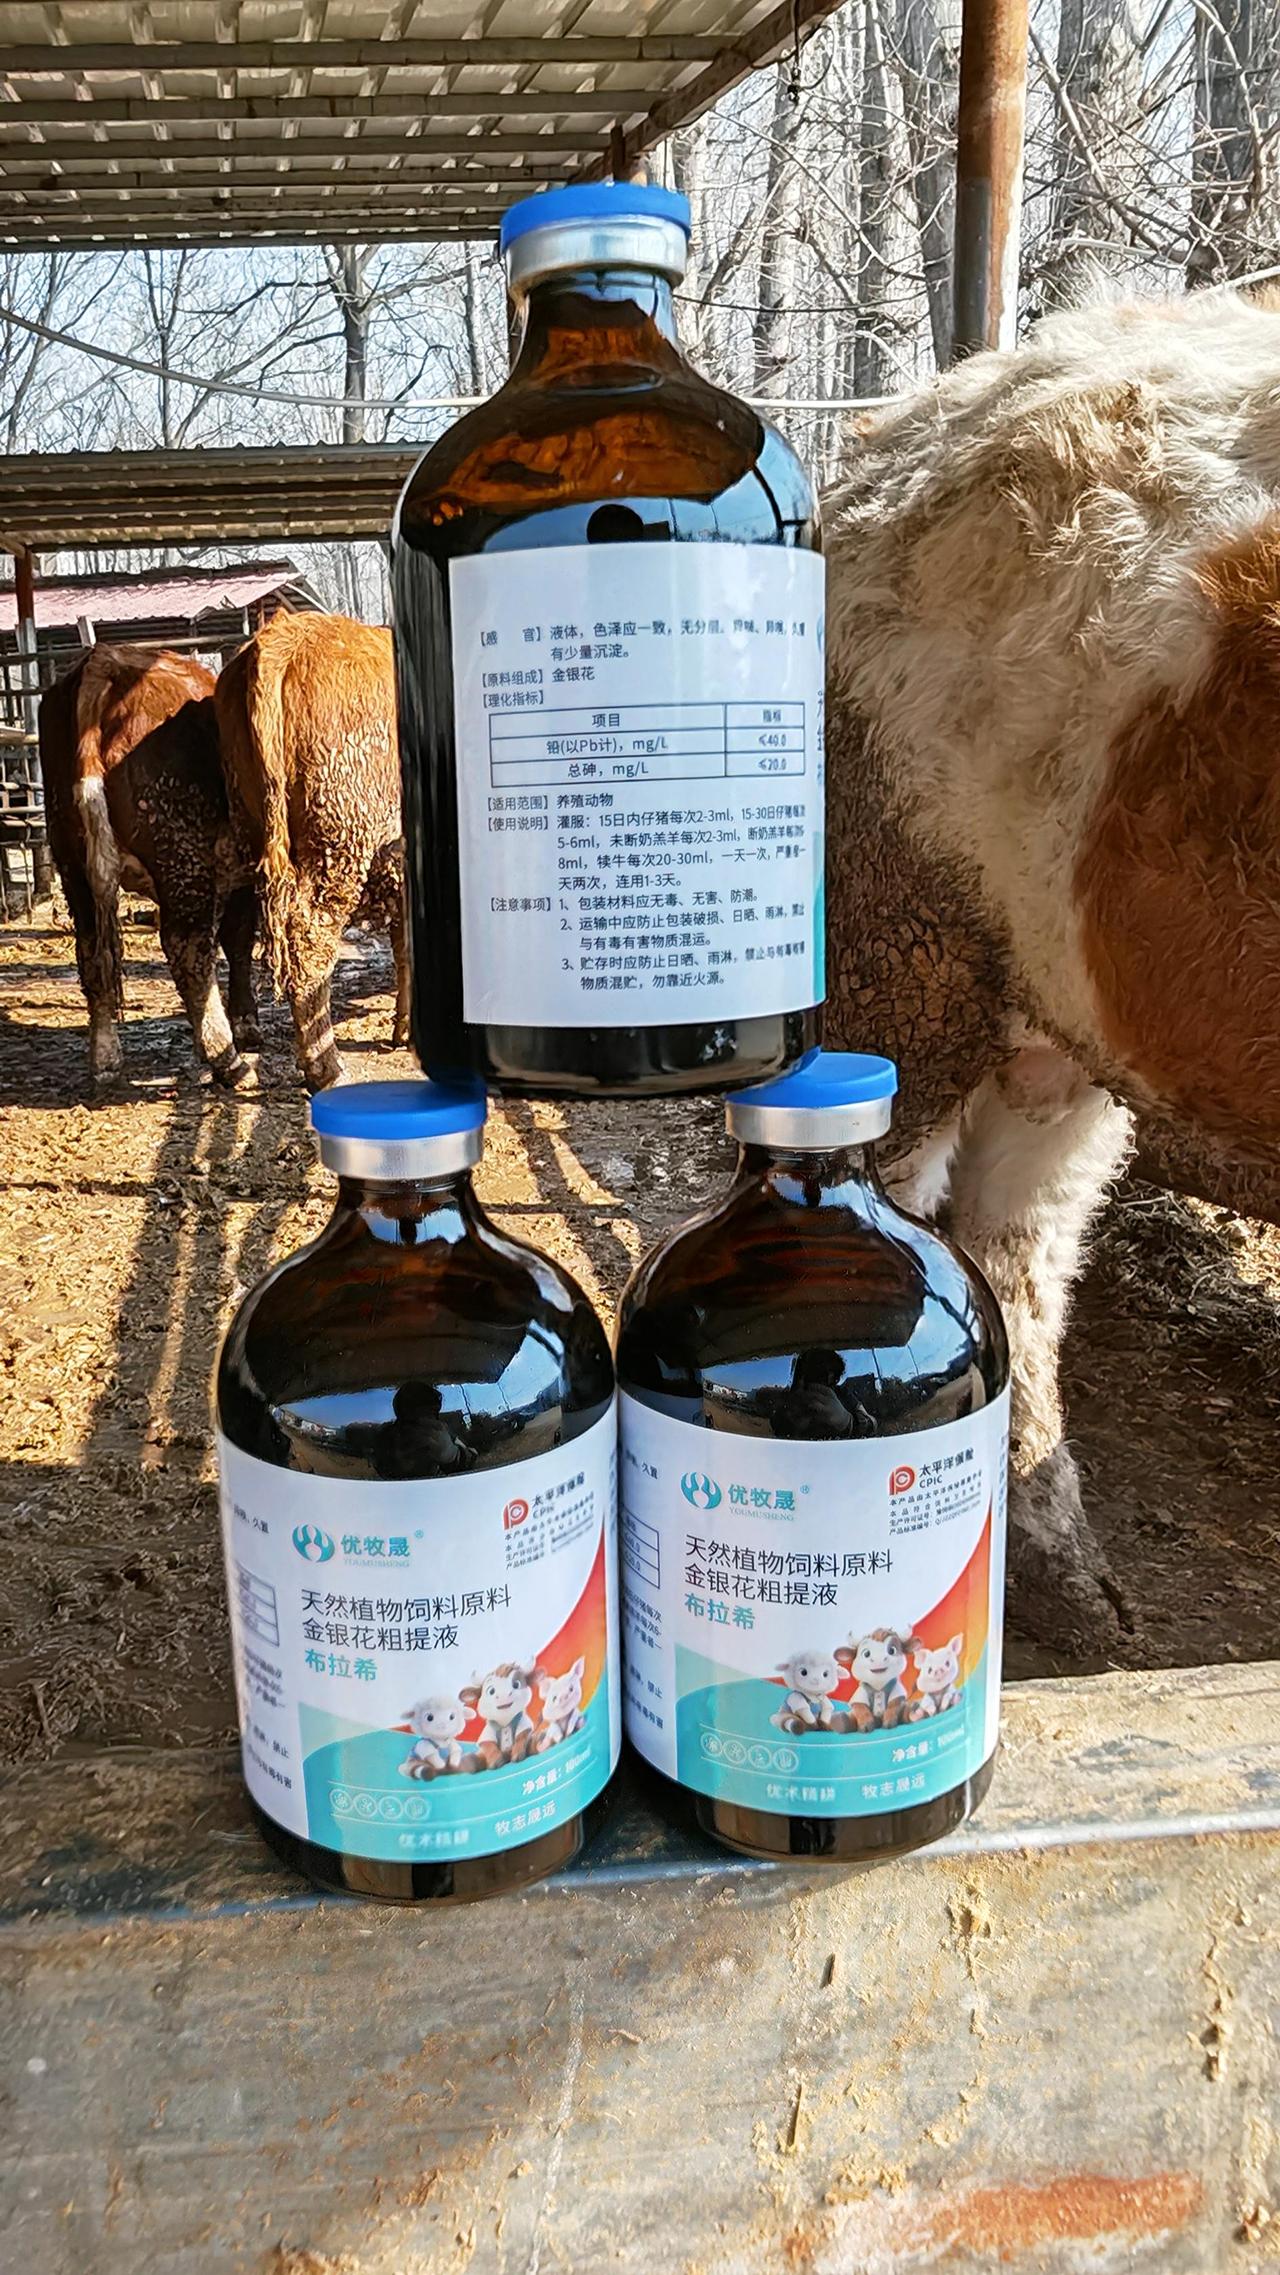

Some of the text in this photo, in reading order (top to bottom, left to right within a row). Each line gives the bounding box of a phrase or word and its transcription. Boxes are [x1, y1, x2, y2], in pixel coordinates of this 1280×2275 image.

[550, 644, 629, 661] 有少量沉淀。
[481, 666, 596, 688] 【原料组成】 金银花
[483, 690, 544, 709] 【理化指标】
[592, 713, 621, 728] 项目
[487, 793, 614, 811] 【适用范围】 养殖动物
[487, 815, 549, 832] 【使用说明】
[558, 874, 682, 891] 天两次，连用1-3天。
[490, 897, 551, 913] 【注意事项】
[579, 933, 712, 951] 与有毒有害物质混运。
[580, 971, 725, 991] 物质混贮，勿靠近火源。
[919, 1475, 943, 1488] CPIC
[727, 1484, 796, 1511] 优牧晟
[341, 1534, 410, 1557] 优牧晟
[686, 1534, 893, 1578] 天然植物饲料原料
[685, 1563, 838, 1607] 金银花粗提液
[301, 1583, 512, 1623] 天然植物饲料原料
[684, 1592, 756, 1630] 布拉希
[302, 1617, 460, 1651] 金银花粗提液
[304, 1648, 378, 1682] 布拉希
